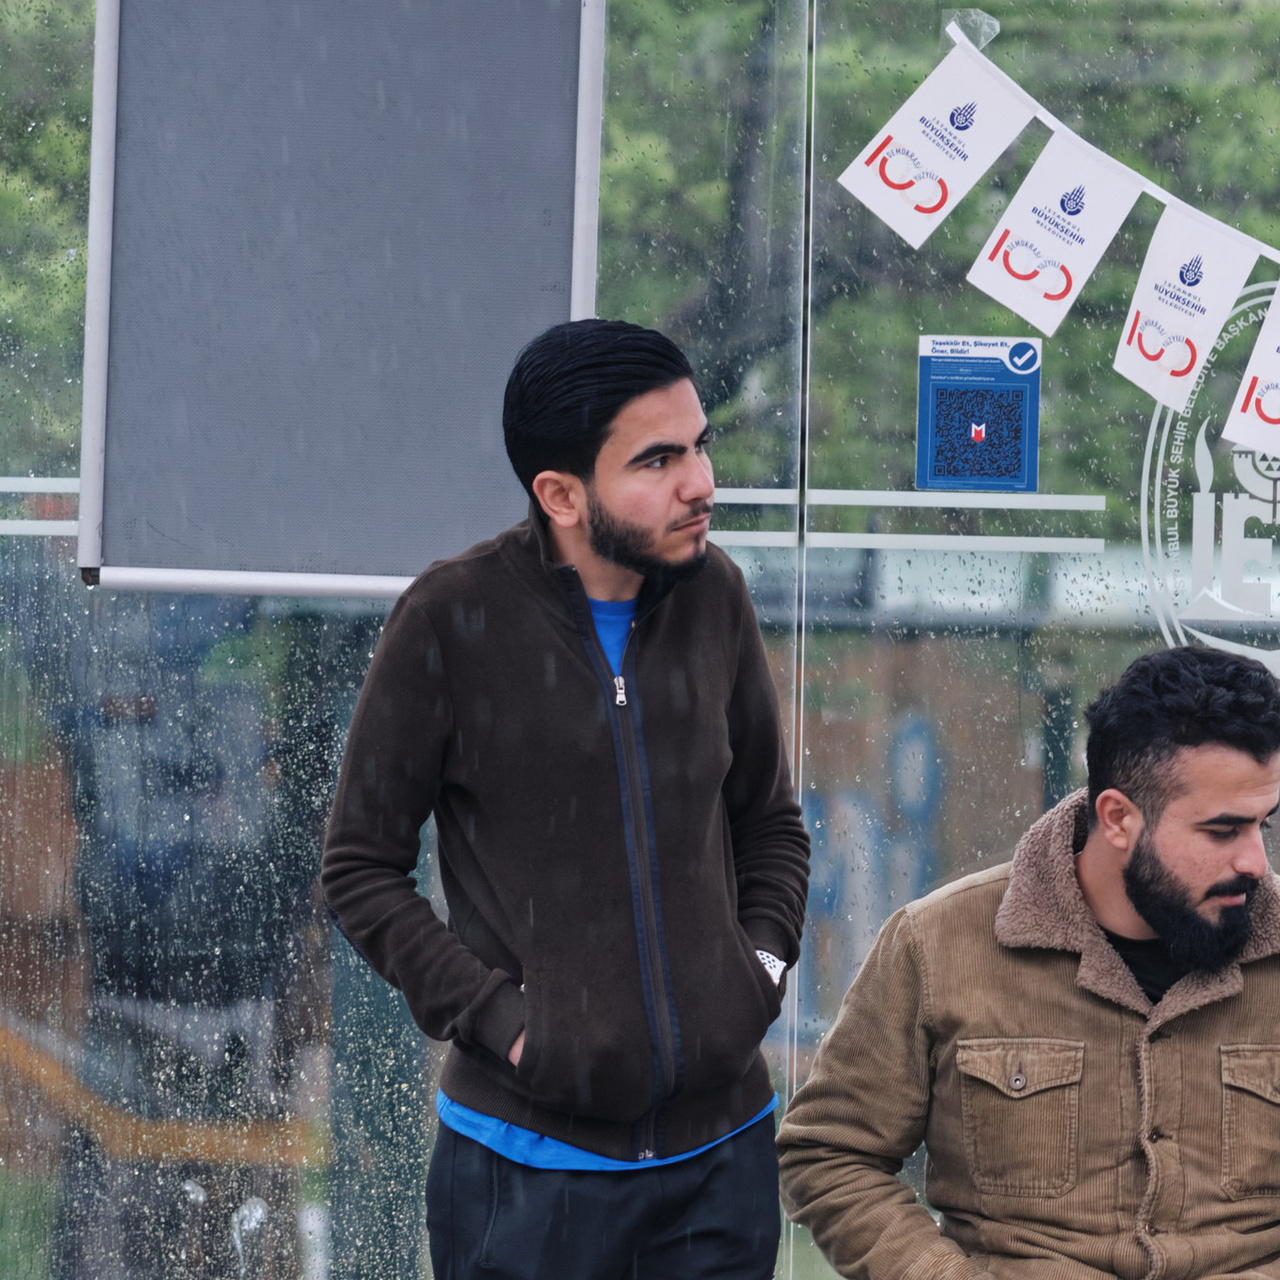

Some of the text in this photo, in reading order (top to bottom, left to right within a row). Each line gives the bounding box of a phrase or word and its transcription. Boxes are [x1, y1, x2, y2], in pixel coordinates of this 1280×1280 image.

[917, 114, 969, 162] BÜYÜKŞEHİR
[1030, 204, 1086, 247] BÜYÜKŞEHİR
[1153, 283, 1207, 316] BÜYÜKŞEHİR
[1216, 307, 1269, 352] BAŞKAN
[1171, 420, 1189, 465] ŞEHİR
[1166, 464, 1181, 519] BÜYÜK
